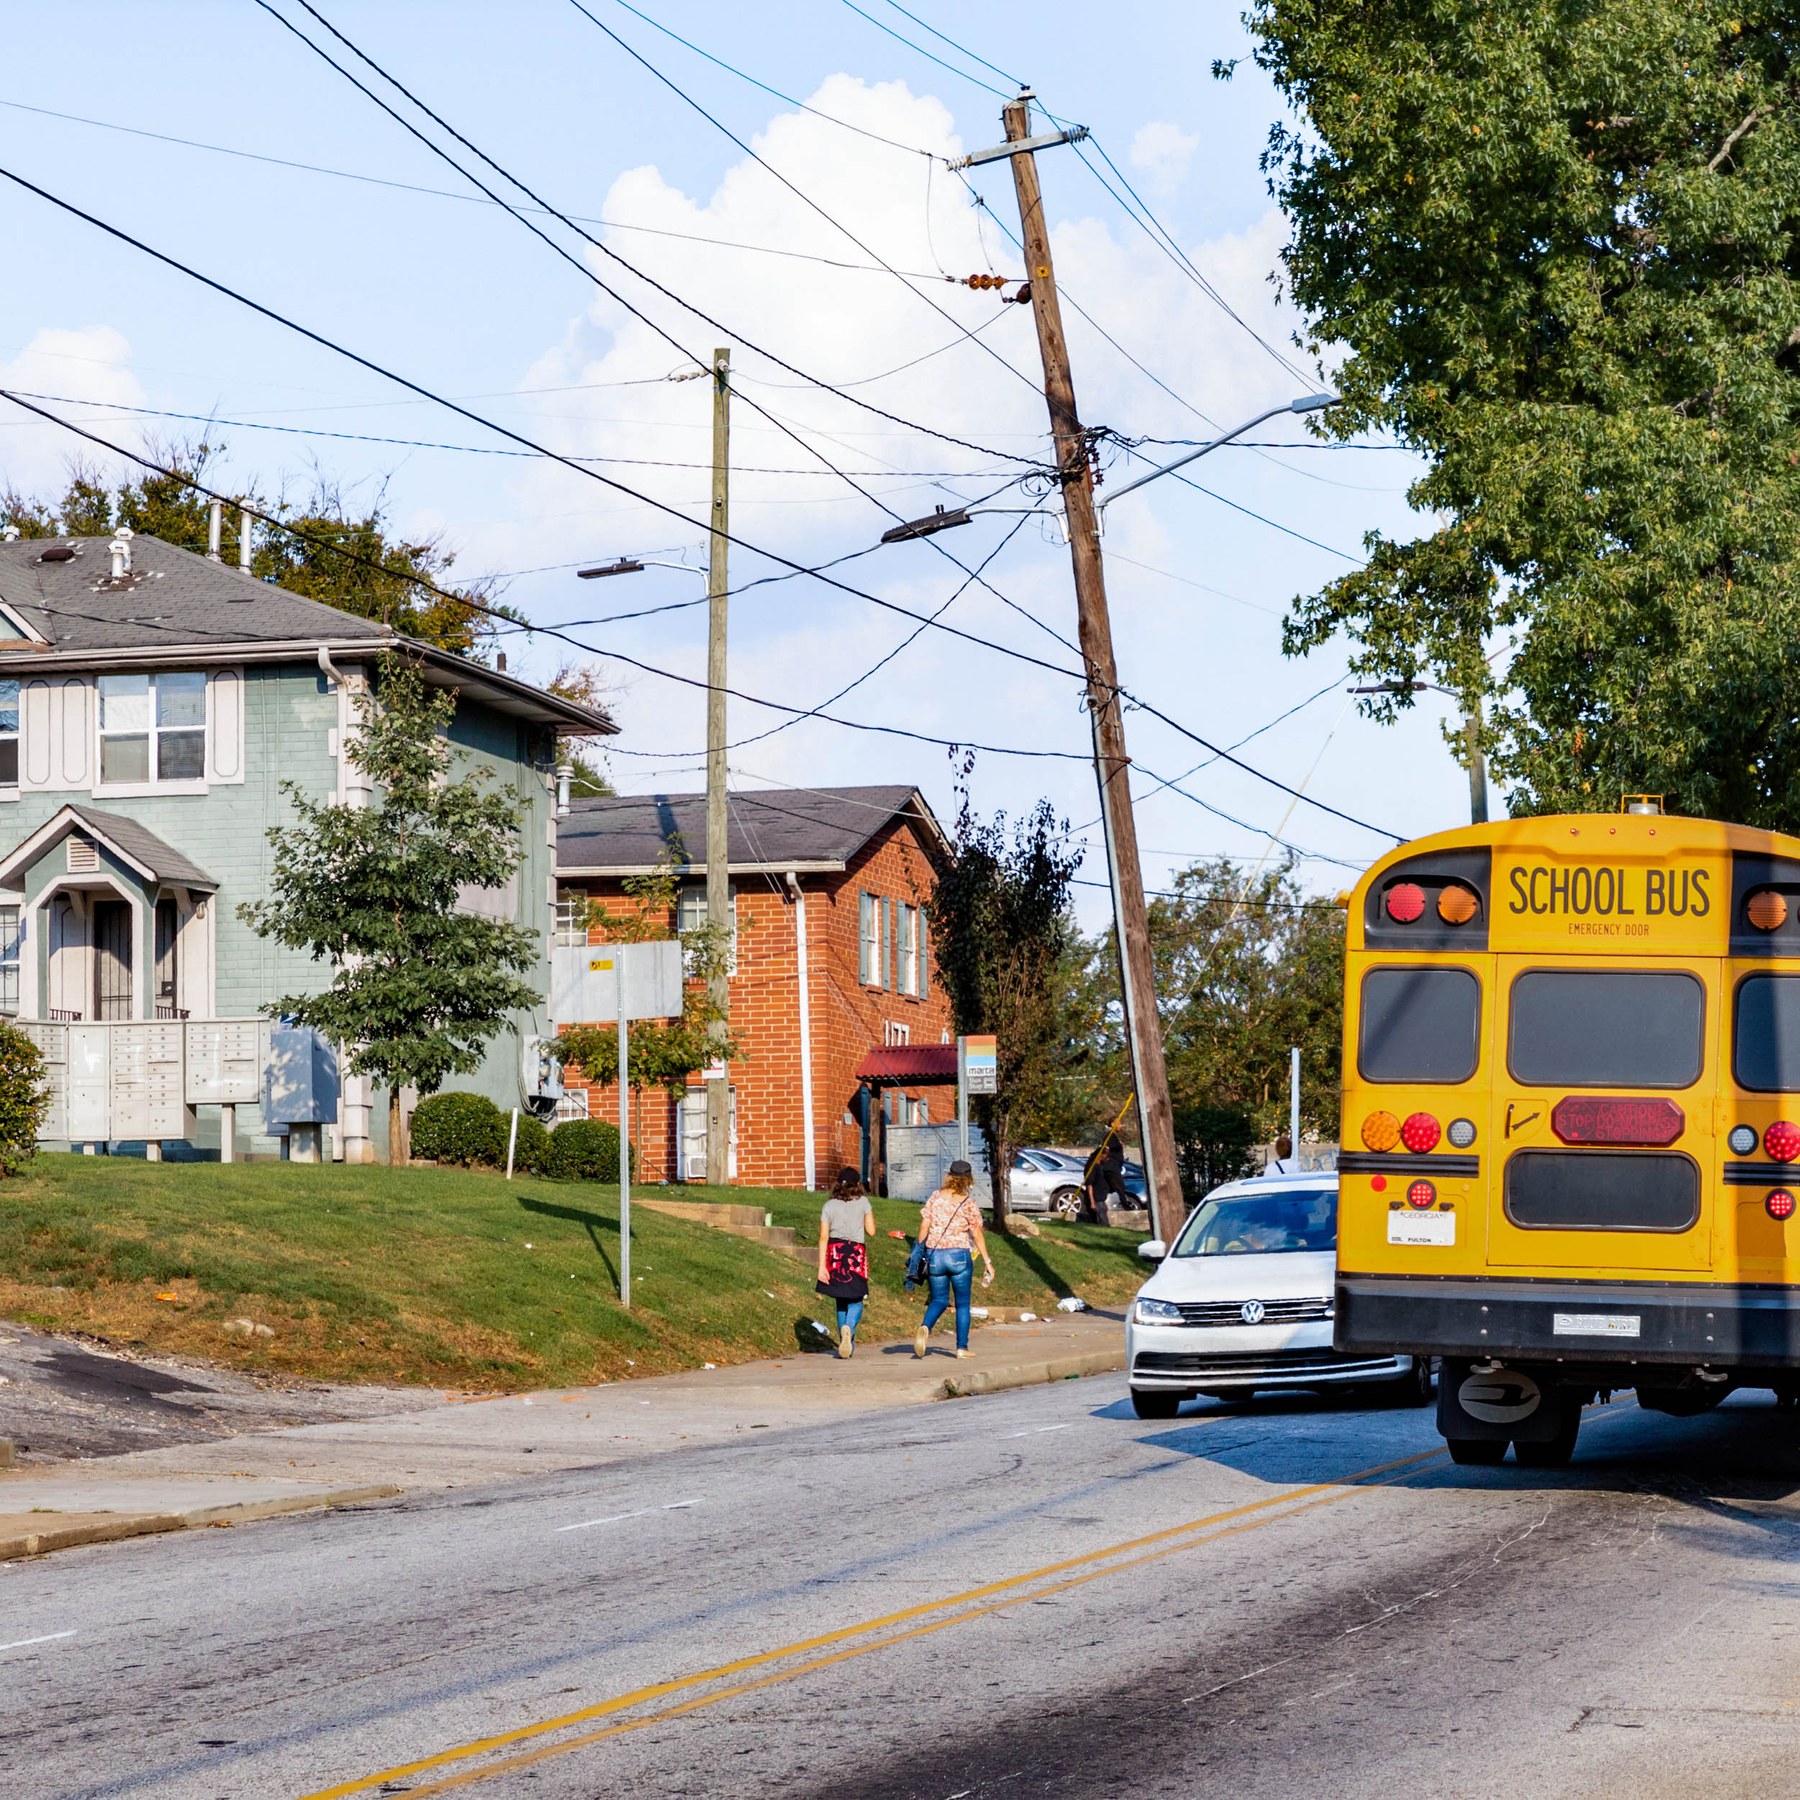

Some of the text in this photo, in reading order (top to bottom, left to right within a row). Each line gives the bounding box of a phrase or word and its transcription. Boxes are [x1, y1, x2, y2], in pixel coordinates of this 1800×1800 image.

[1509, 867, 1710, 917] SCHOOL BUS
[1568, 923, 1650, 936] EMERGENCY DOOR
[968, 1067, 994, 1075] marta
[1559, 1113, 1593, 1128] STOP
